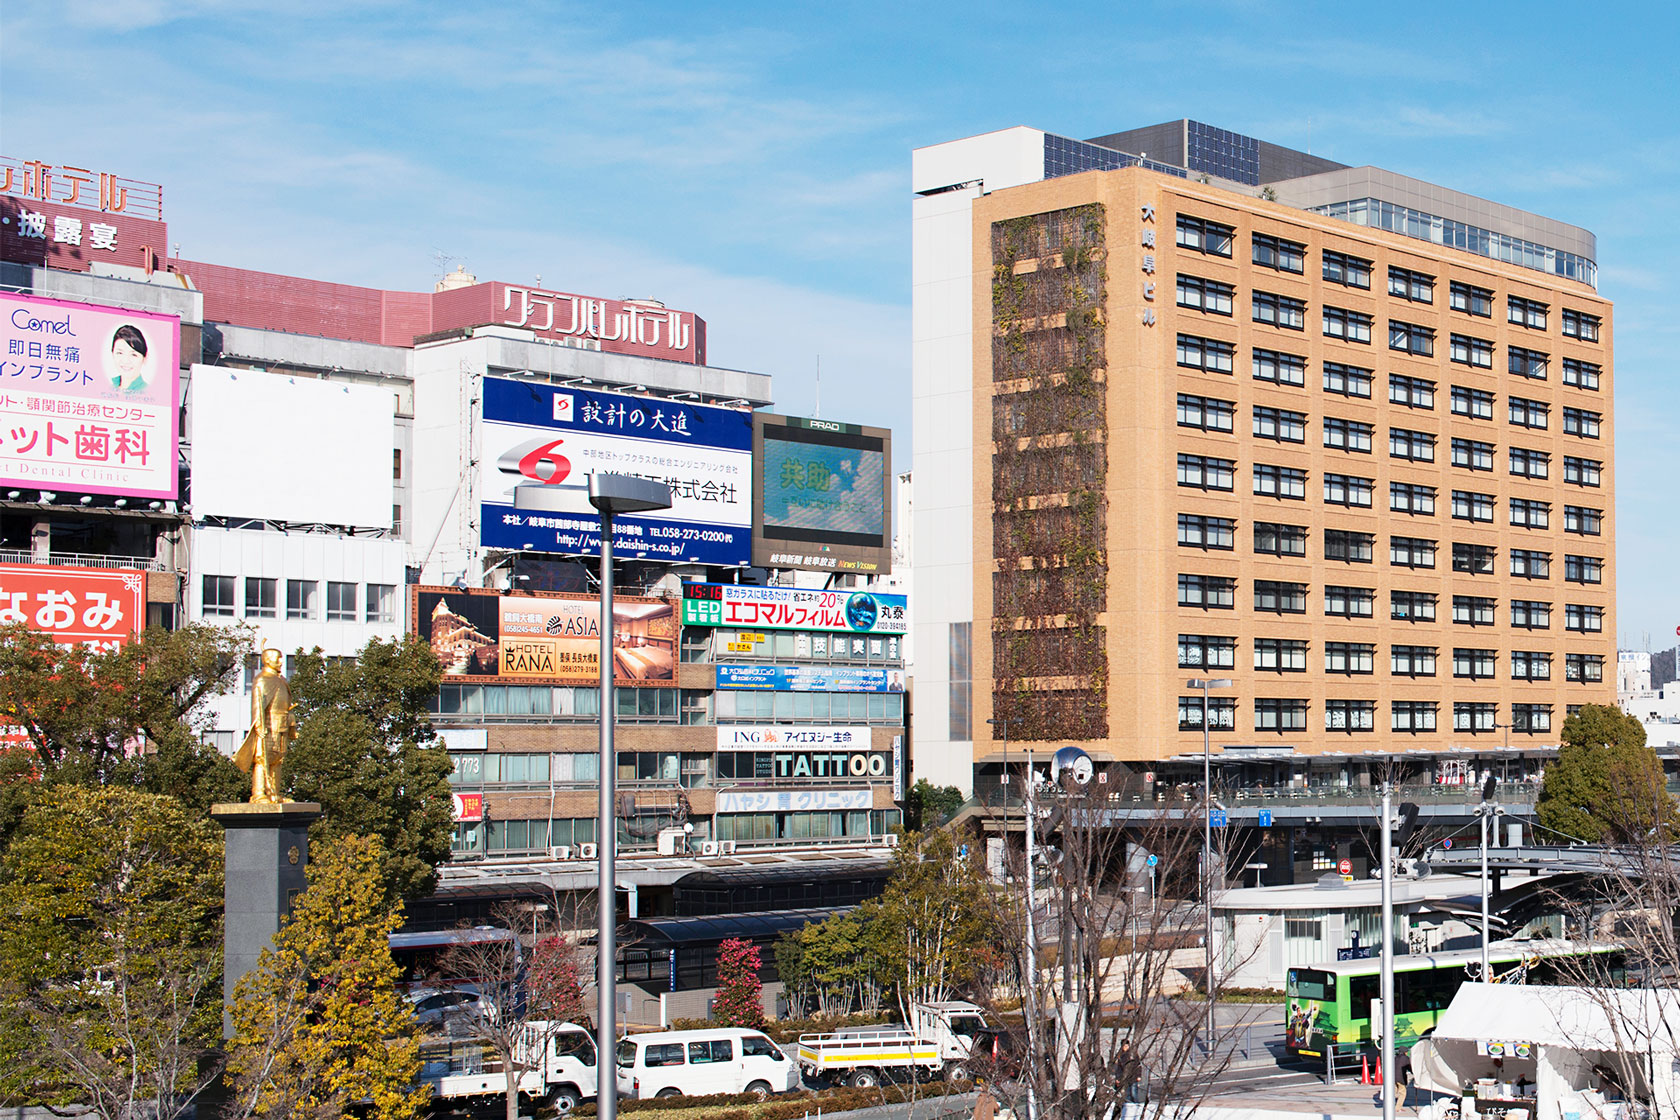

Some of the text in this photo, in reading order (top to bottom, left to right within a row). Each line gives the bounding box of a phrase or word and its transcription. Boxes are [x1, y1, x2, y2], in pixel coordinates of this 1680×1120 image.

[1141, 202, 1155, 328] 大岐阜ビル
[11, 309, 76, 337] Comet
[8, 339, 81, 364] 即日無痛
[580, 400, 692, 437] 設計の大進
[0, 421, 150, 466] ット歯科
[20, 463, 71, 478] Dental
[81, 468, 129, 483] Clinic
[780, 457, 831, 493] 共助
[583, 468, 738, 504] 株式会社
[556, 531, 685, 556] http://w.daishin-s.co.jp/
[690, 585, 722, 599] 15:16
[0, 588, 124, 631] なおみ
[563, 605, 584, 614] HOTEL
[687, 601, 720, 613] LED
[725, 601, 846, 627] エコマルフィルム
[564, 616, 599, 636] ASIA
[516, 645, 553, 654] HOTEL
[506, 653, 553, 672] RANA
[734, 731, 760, 743] ING
[776, 754, 885, 776] TATTOO
